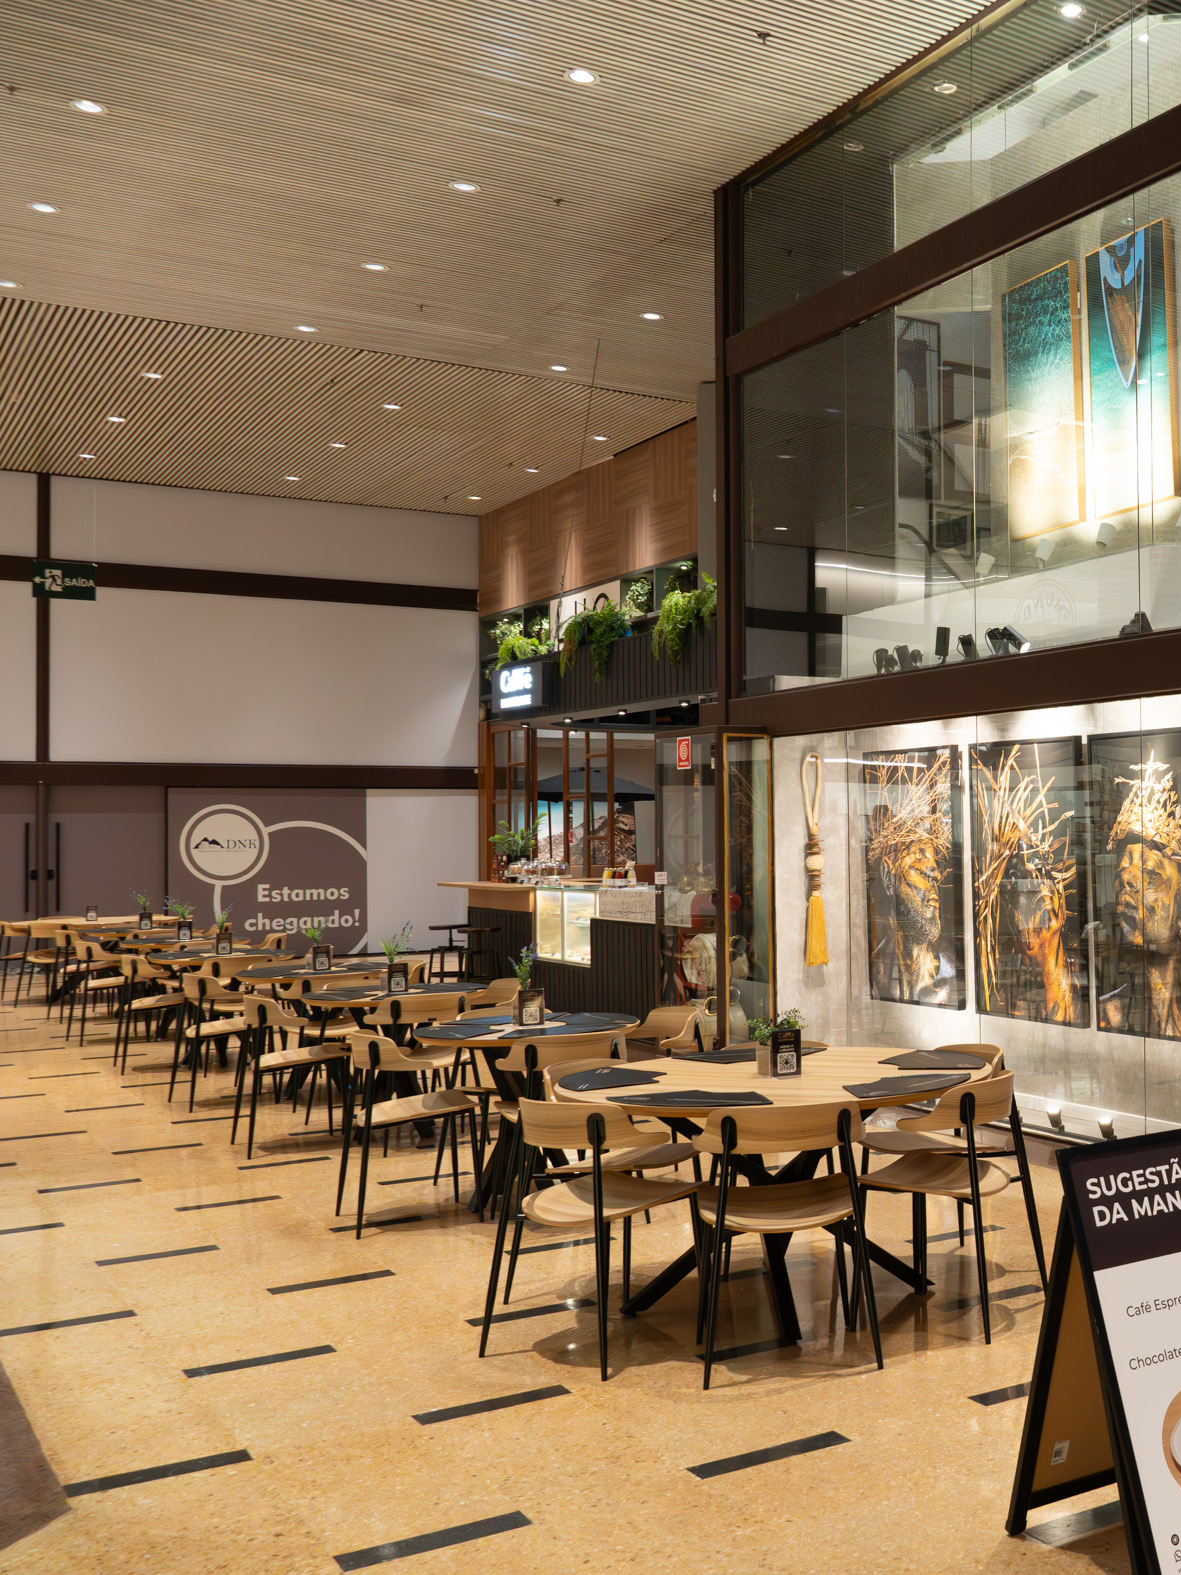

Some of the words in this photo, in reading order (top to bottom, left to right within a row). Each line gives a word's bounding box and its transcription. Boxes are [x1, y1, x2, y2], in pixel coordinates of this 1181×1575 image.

[64, 576, 96, 587] SAÍDA
[226, 839, 258, 850] DNK
[257, 883, 350, 903] Estamos
[244, 908, 361, 934] chegando!
[1092, 1201, 1129, 1228] DA
[1126, 1301, 1151, 1318] Café
